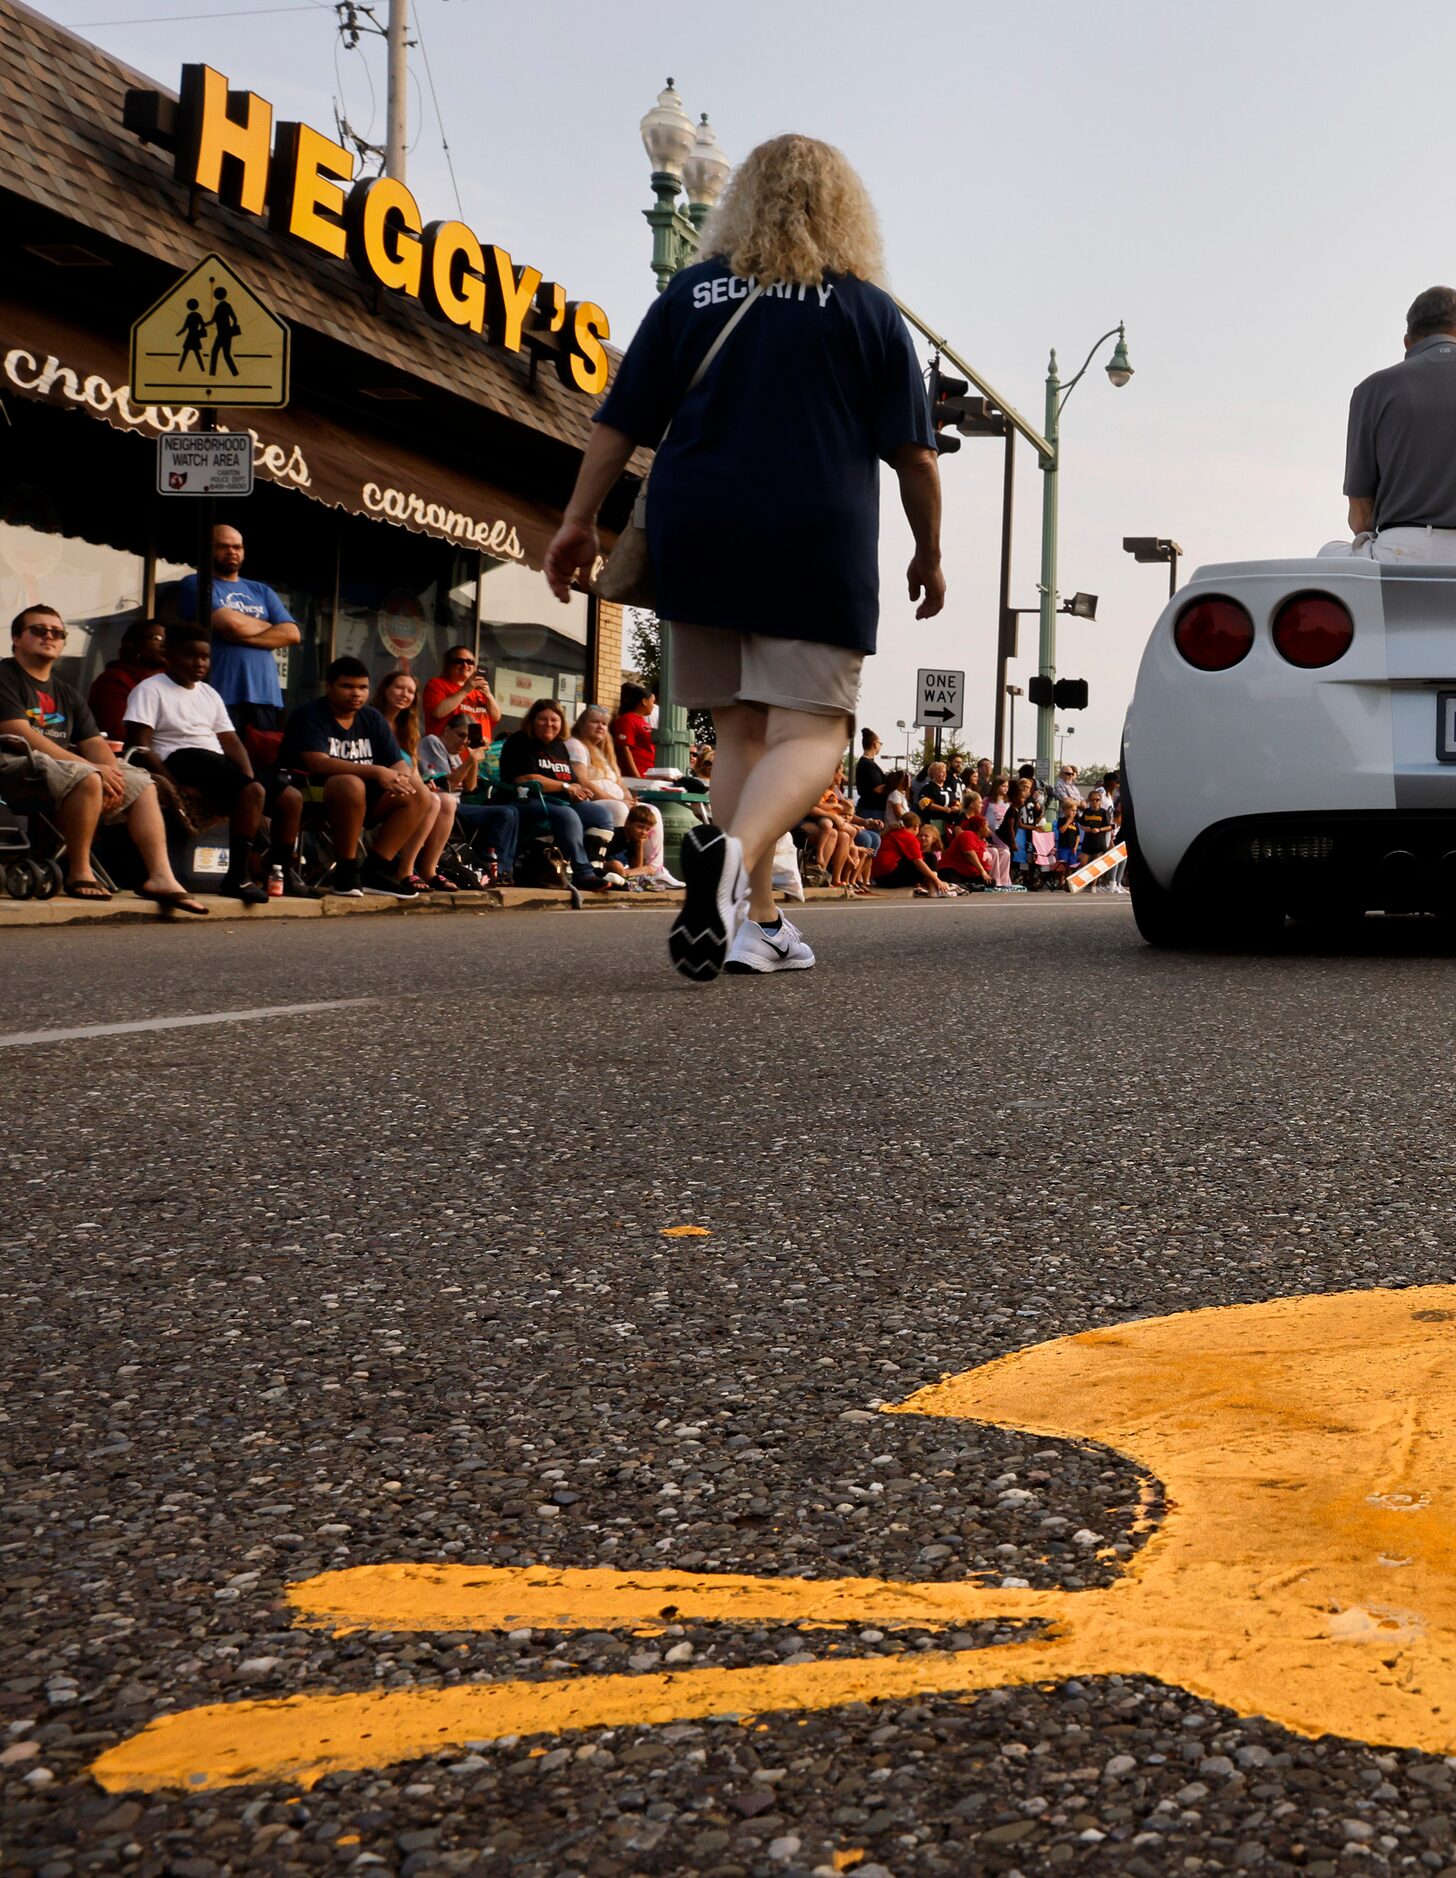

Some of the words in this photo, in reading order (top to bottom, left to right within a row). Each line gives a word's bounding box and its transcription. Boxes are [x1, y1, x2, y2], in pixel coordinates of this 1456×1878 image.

[195, 62, 611, 395] HEGGY'S
[164, 437, 247, 452] NEIGHBORHOOD
[172, 453, 209, 467] WATCH
[212, 453, 240, 467] AREA
[362, 482, 525, 559] caramels
[926, 674, 956, 688] ONE
[925, 690, 956, 703] WAY
